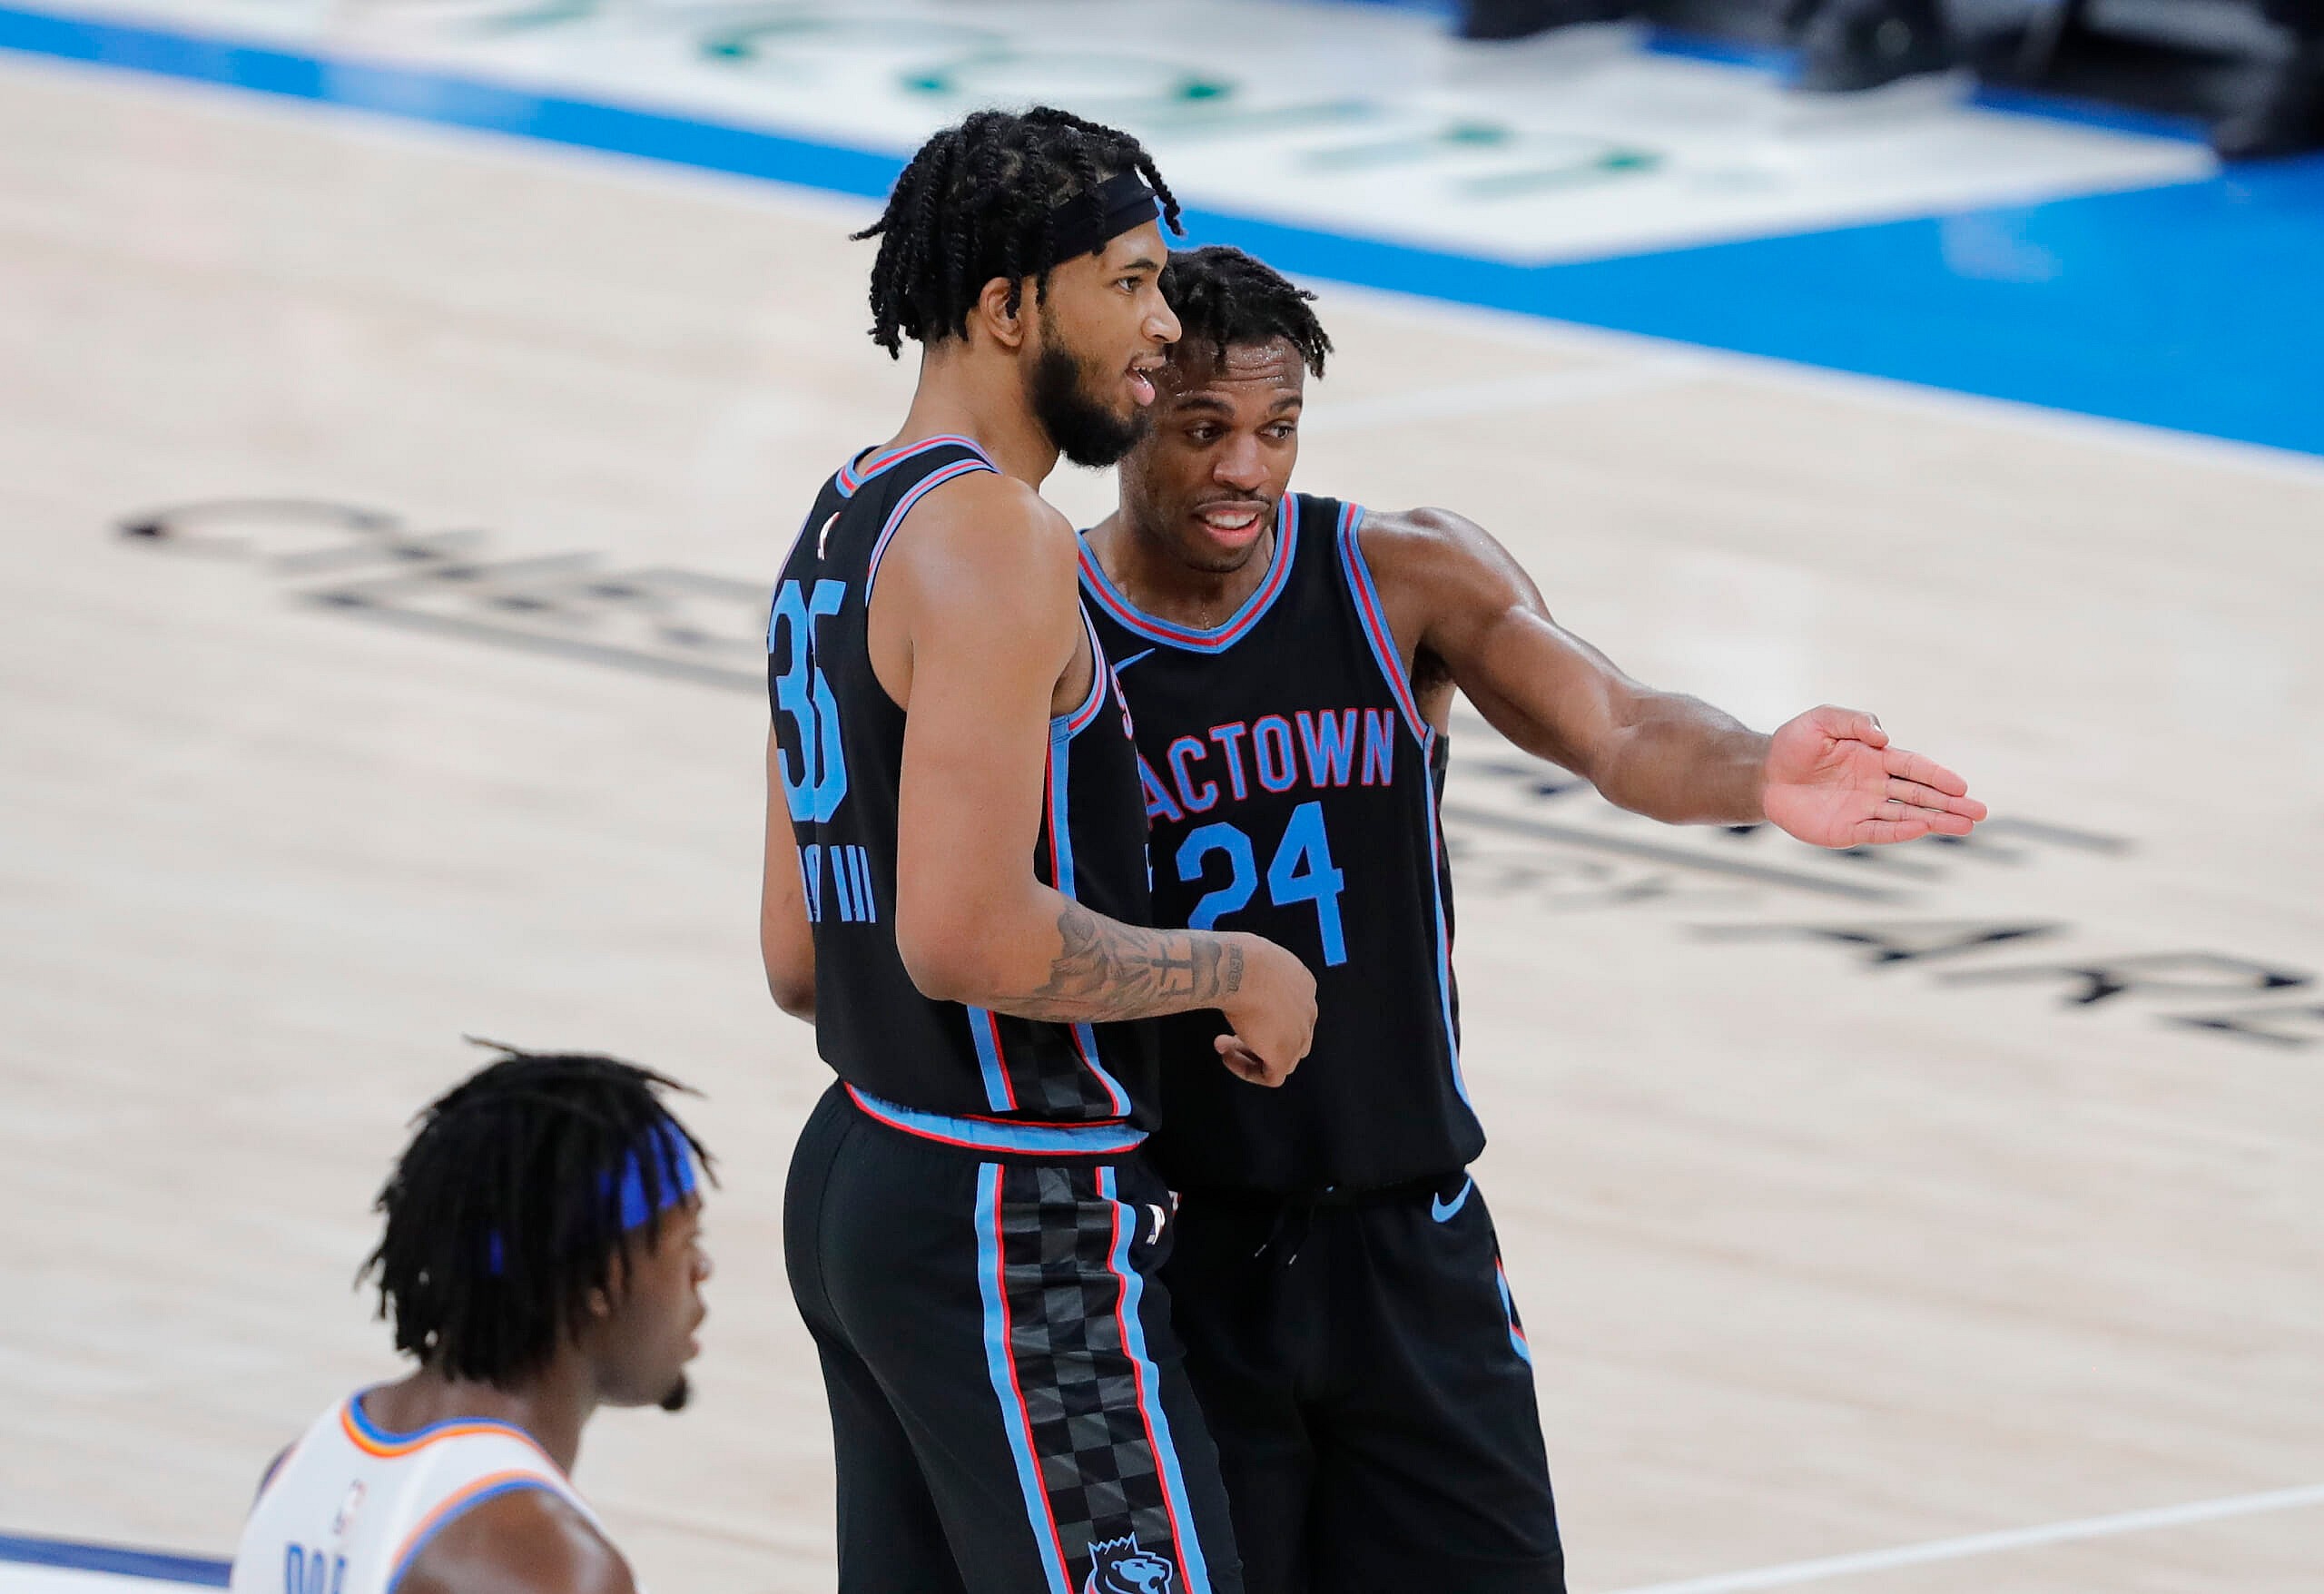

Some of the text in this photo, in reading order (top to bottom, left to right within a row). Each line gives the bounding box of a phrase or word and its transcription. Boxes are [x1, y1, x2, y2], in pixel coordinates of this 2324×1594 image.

[767, 579, 848, 823] 35
[1136, 708, 1394, 830] ACTOWN
[1176, 800, 1348, 968] 24
